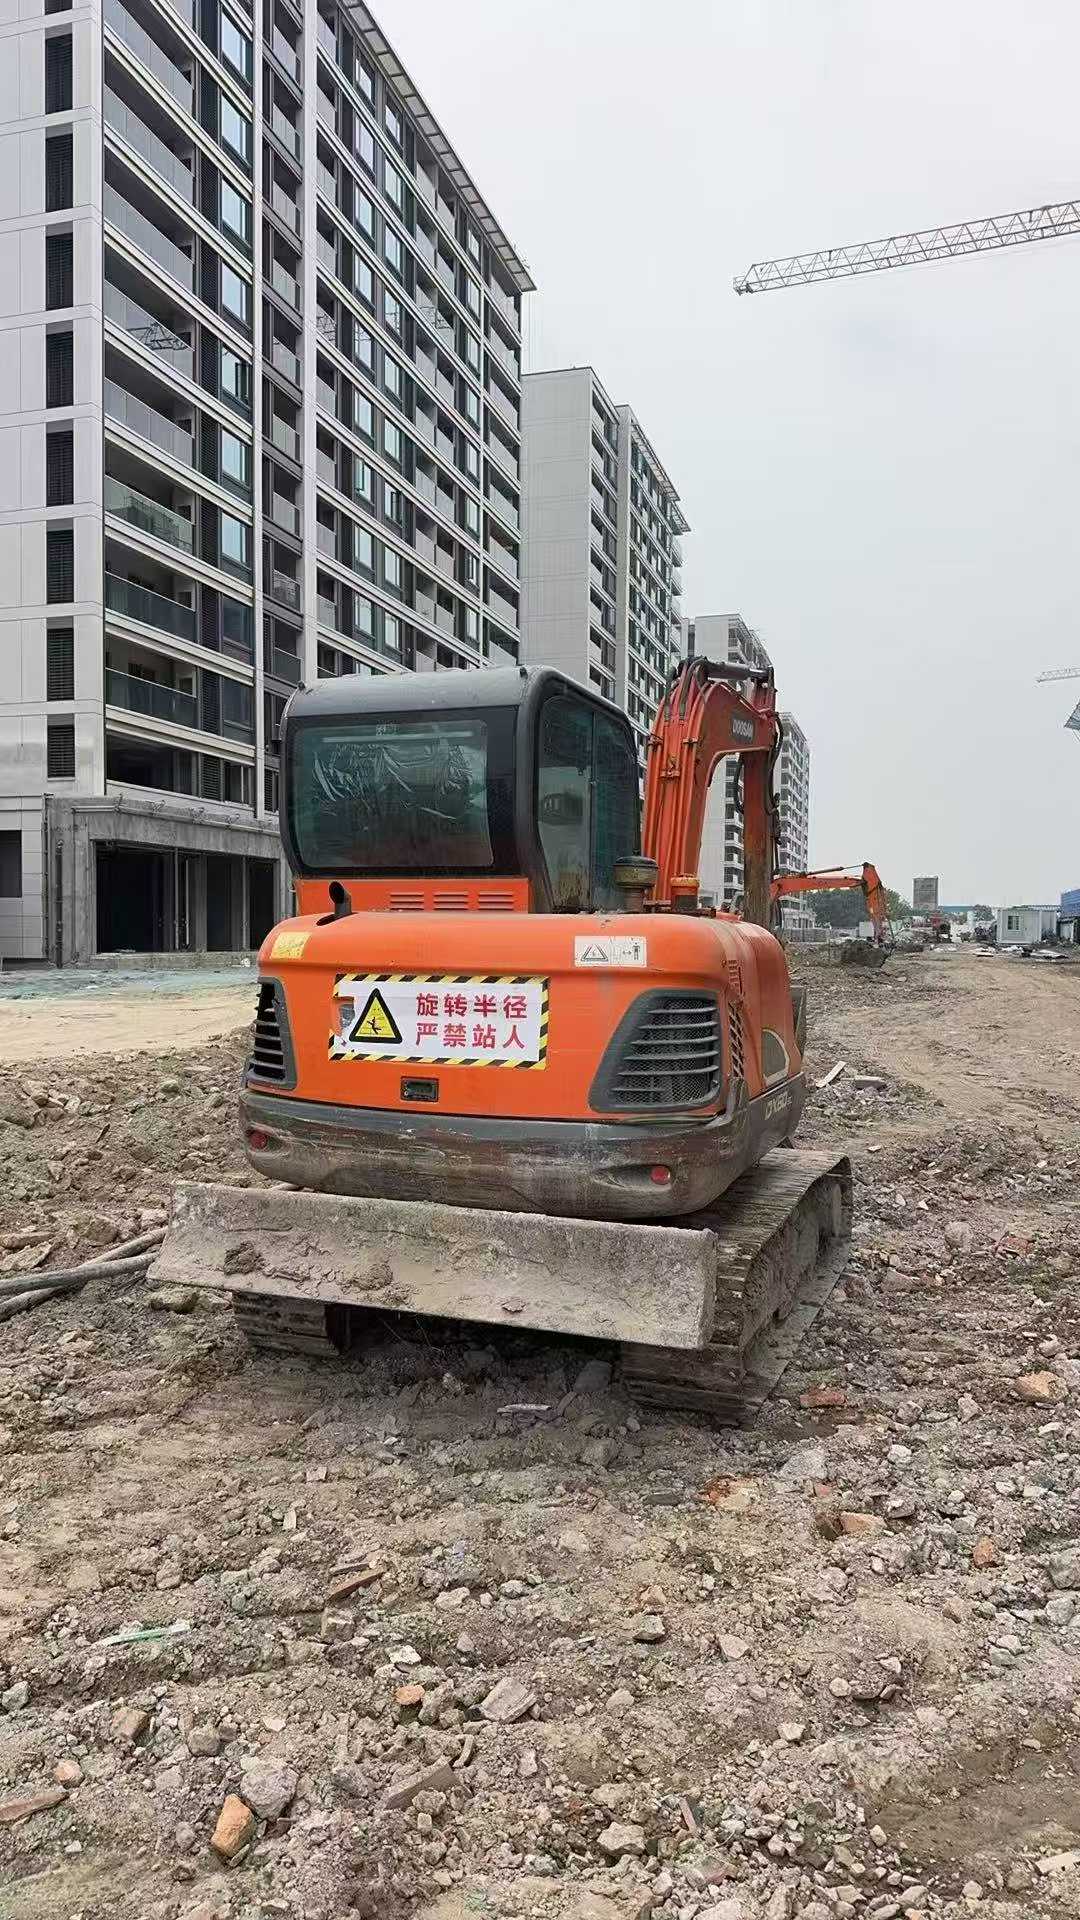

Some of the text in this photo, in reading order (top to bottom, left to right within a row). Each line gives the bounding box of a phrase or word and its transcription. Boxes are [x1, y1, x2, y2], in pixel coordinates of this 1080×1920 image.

[416, 993, 527, 1019] 旋转半径
[416, 1022, 525, 1049] 严禁站人
